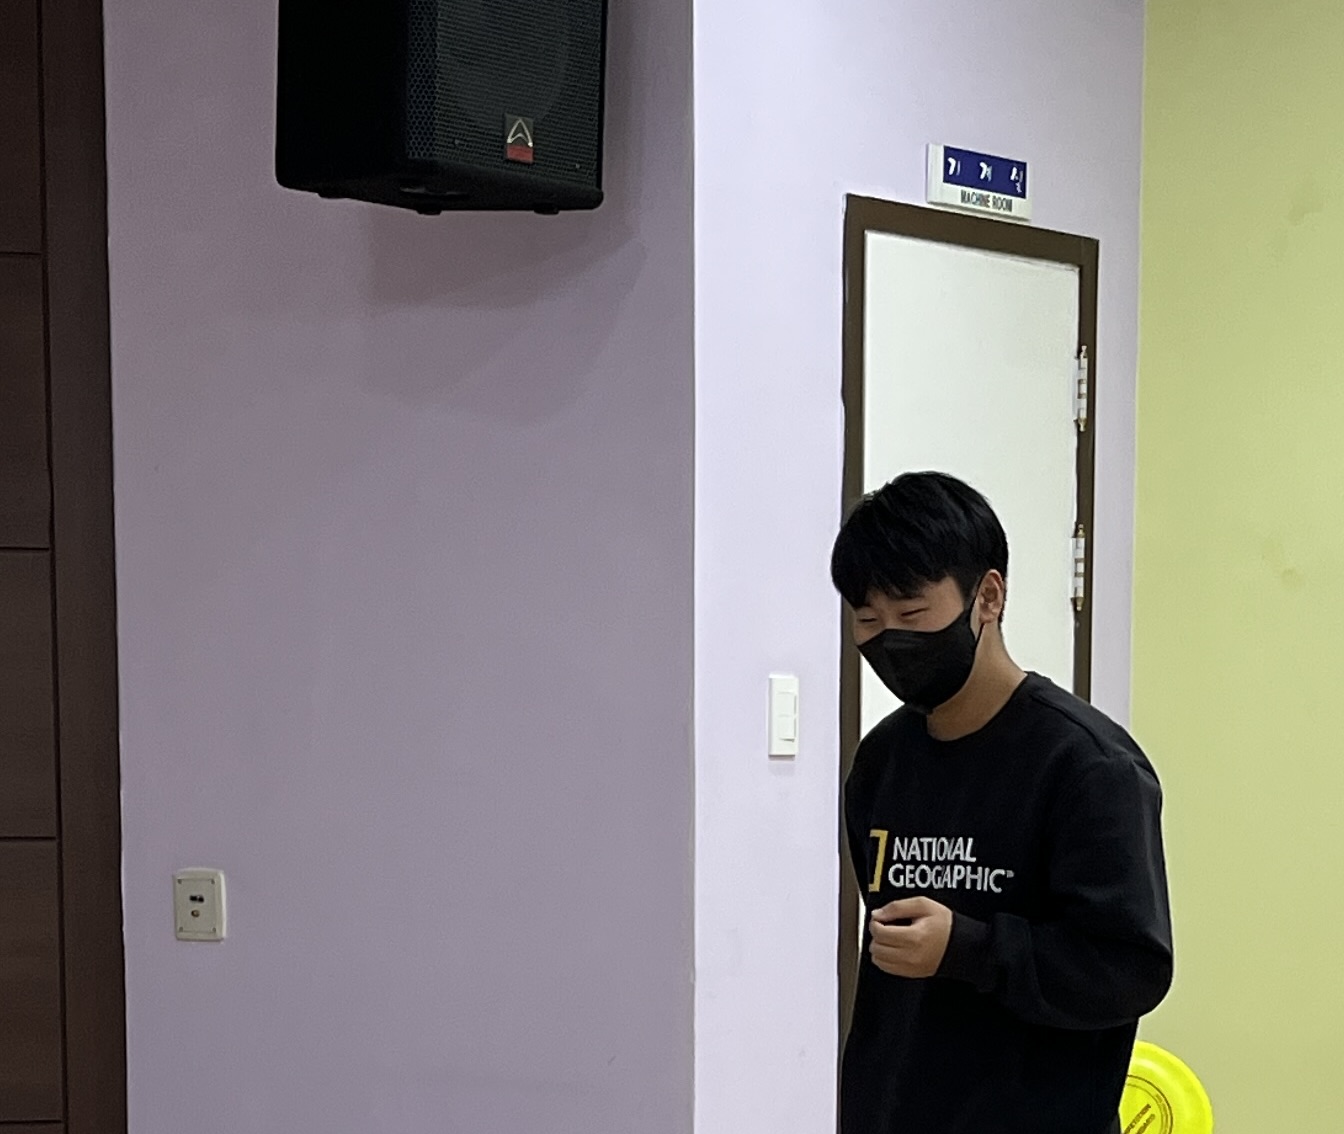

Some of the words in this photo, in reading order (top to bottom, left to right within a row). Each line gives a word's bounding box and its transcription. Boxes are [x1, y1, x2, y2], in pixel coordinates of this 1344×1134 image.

[960, 189, 991, 208] MACHINE
[992, 195, 1013, 212] ROOM
[888, 863, 1007, 894] GEOGAPHIC
